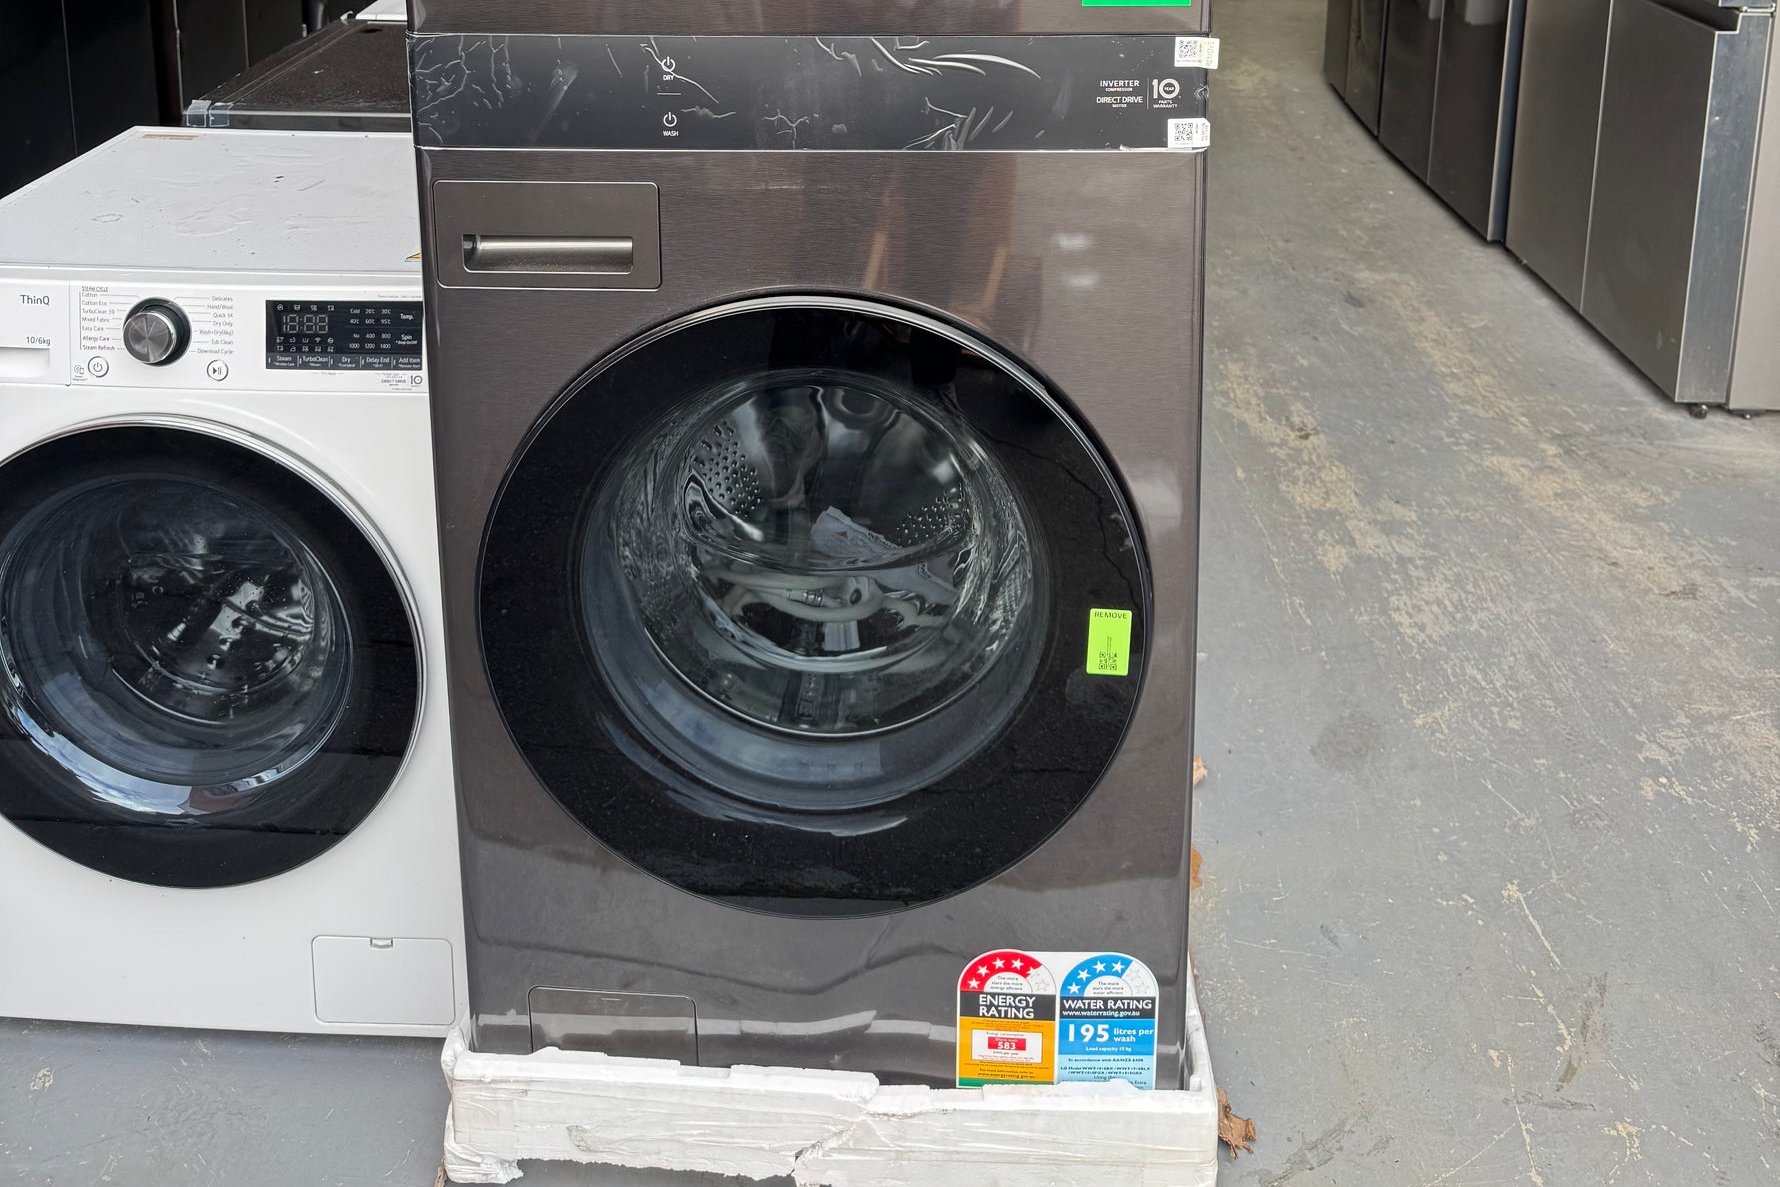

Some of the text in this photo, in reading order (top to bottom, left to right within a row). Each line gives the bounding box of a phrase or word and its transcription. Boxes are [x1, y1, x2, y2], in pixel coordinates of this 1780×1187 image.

[1152, 78, 1180, 99] 10
[20, 294, 50, 306] ThinQ
[26, 336, 50, 346] 10/6kg
[979, 994, 1036, 1007] ENERGY
[1063, 1000, 1152, 1009] WATER RATING
[979, 1006, 1034, 1019] RATING
[1068, 1023, 1110, 1043] 195
[1114, 1027, 1154, 1037] litres per
[998, 1042, 1016, 1050] 583
